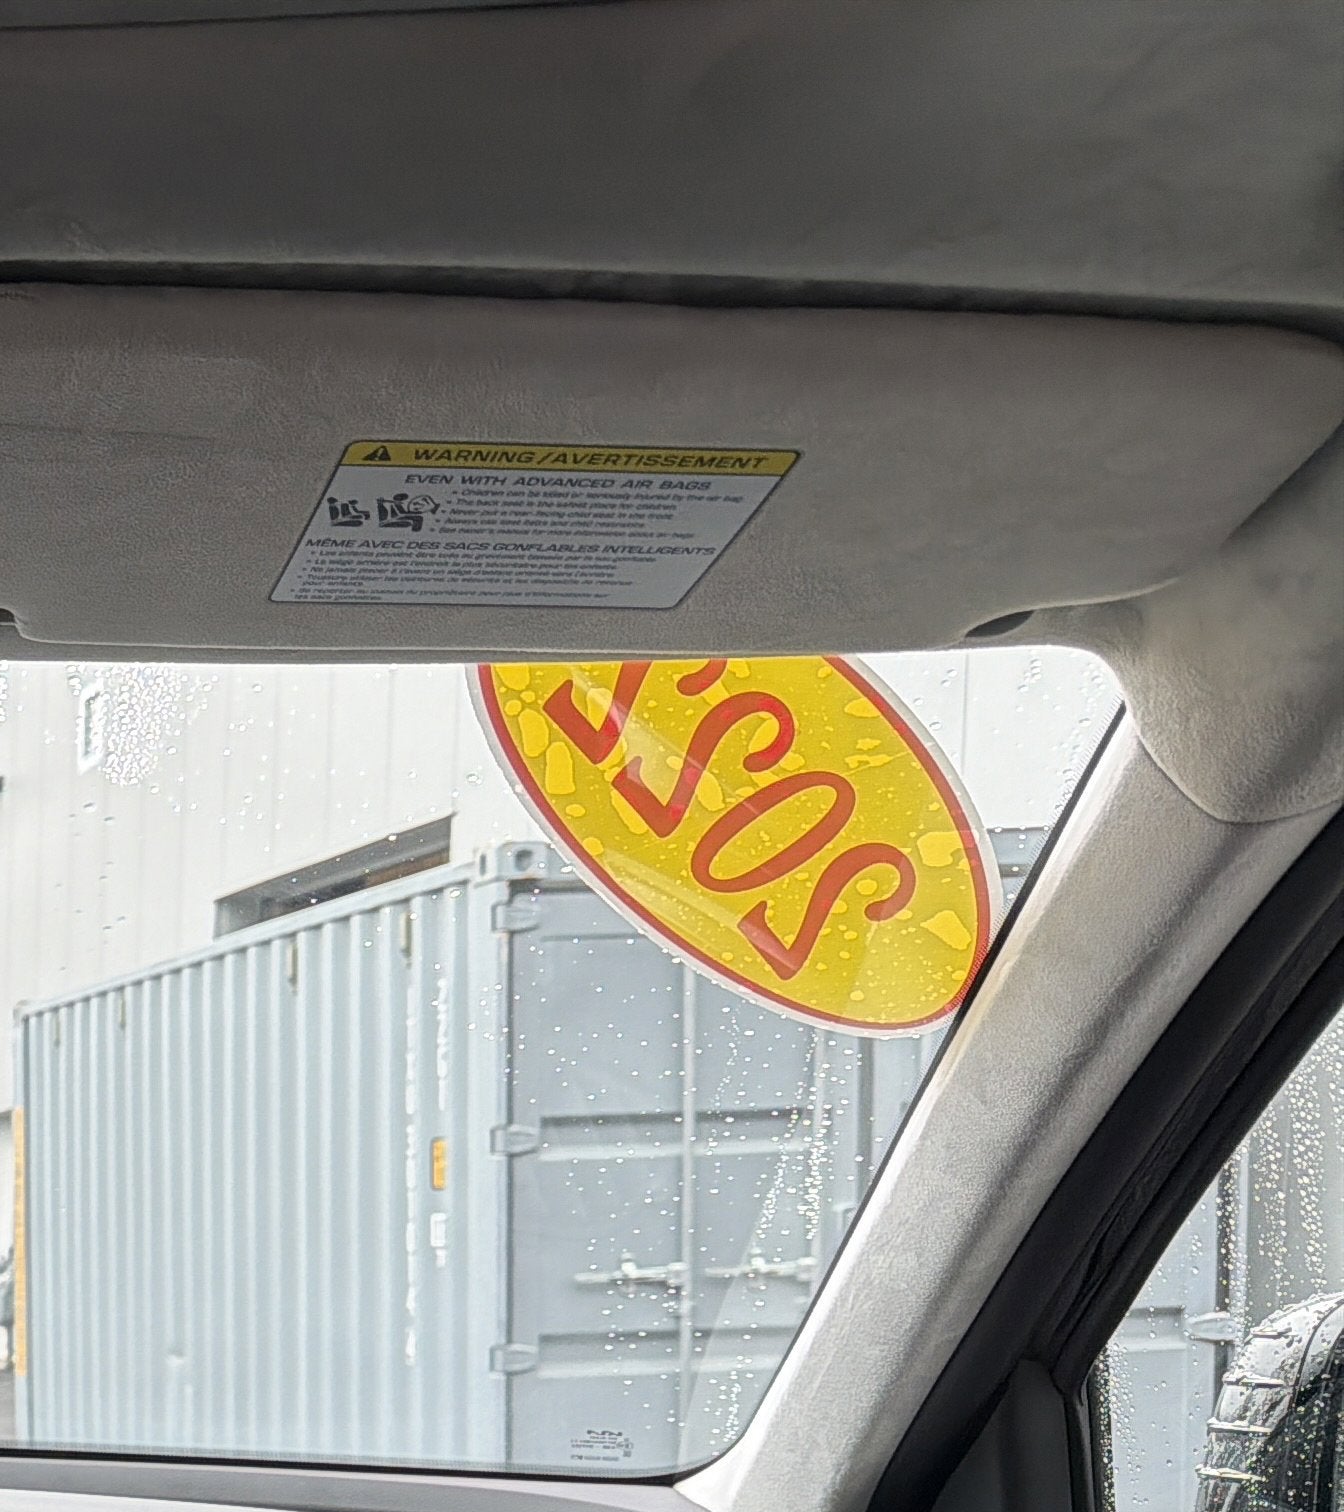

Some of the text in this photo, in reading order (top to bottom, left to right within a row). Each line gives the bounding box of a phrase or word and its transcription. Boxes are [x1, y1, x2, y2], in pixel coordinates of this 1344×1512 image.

[405, 474, 712, 492] EVEN WITH ADVANCED AIR BAGS
[357, 538, 407, 550] AVEC
[408, 540, 444, 551] DES
[446, 541, 491, 552] SACS
[491, 542, 600, 554] GONFLABLES
